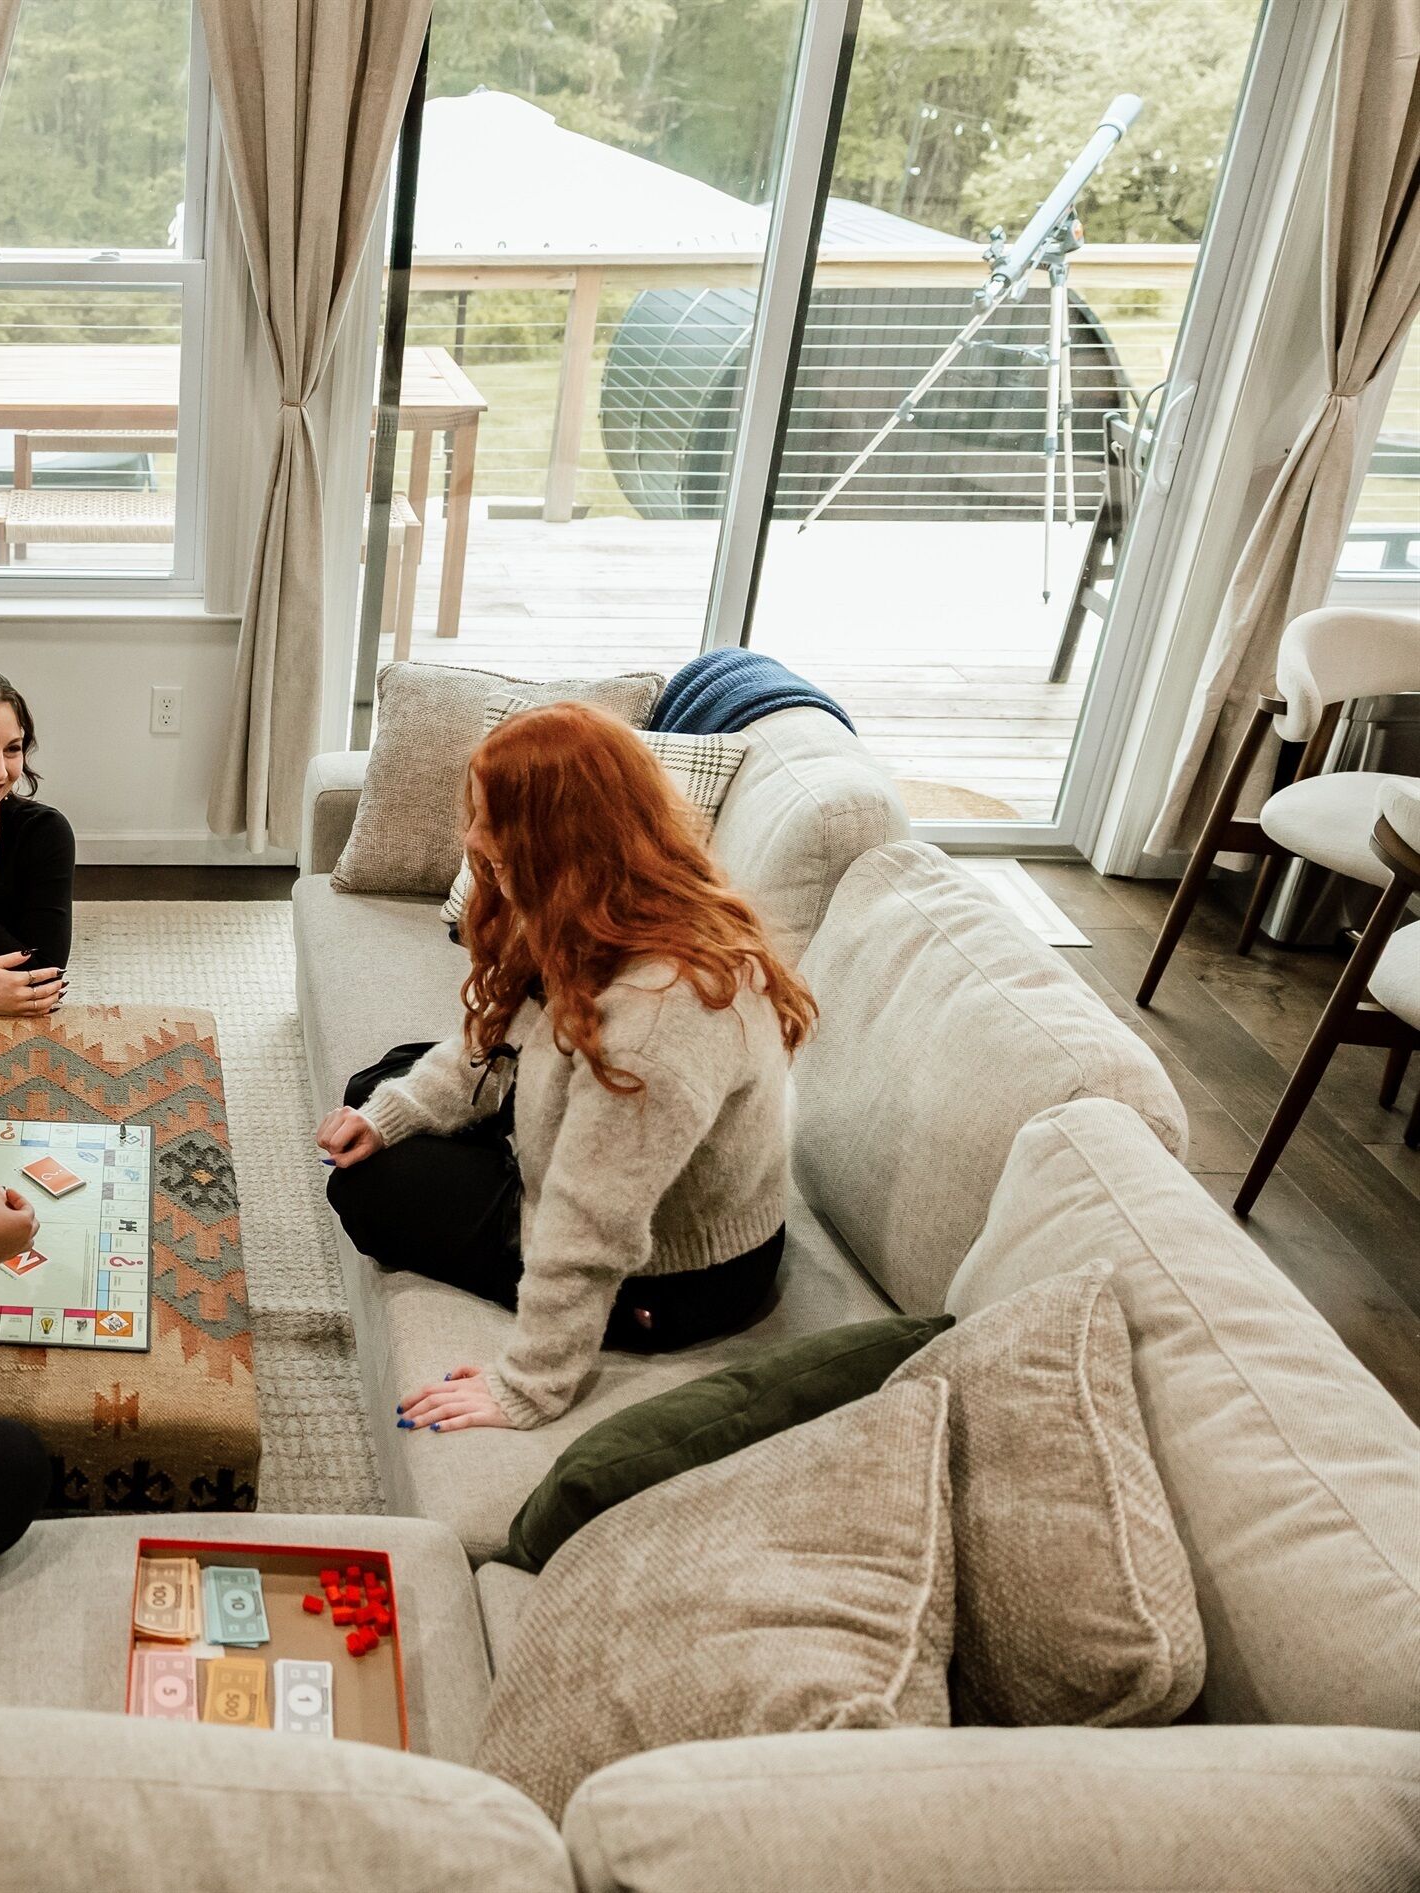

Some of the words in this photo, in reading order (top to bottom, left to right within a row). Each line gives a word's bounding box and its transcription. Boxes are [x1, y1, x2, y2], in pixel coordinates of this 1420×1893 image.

[152, 1586, 167, 1607] 100
[231, 1597, 245, 1611] 10
[162, 1686, 178, 1697] 5
[224, 1693, 240, 1718] 500
